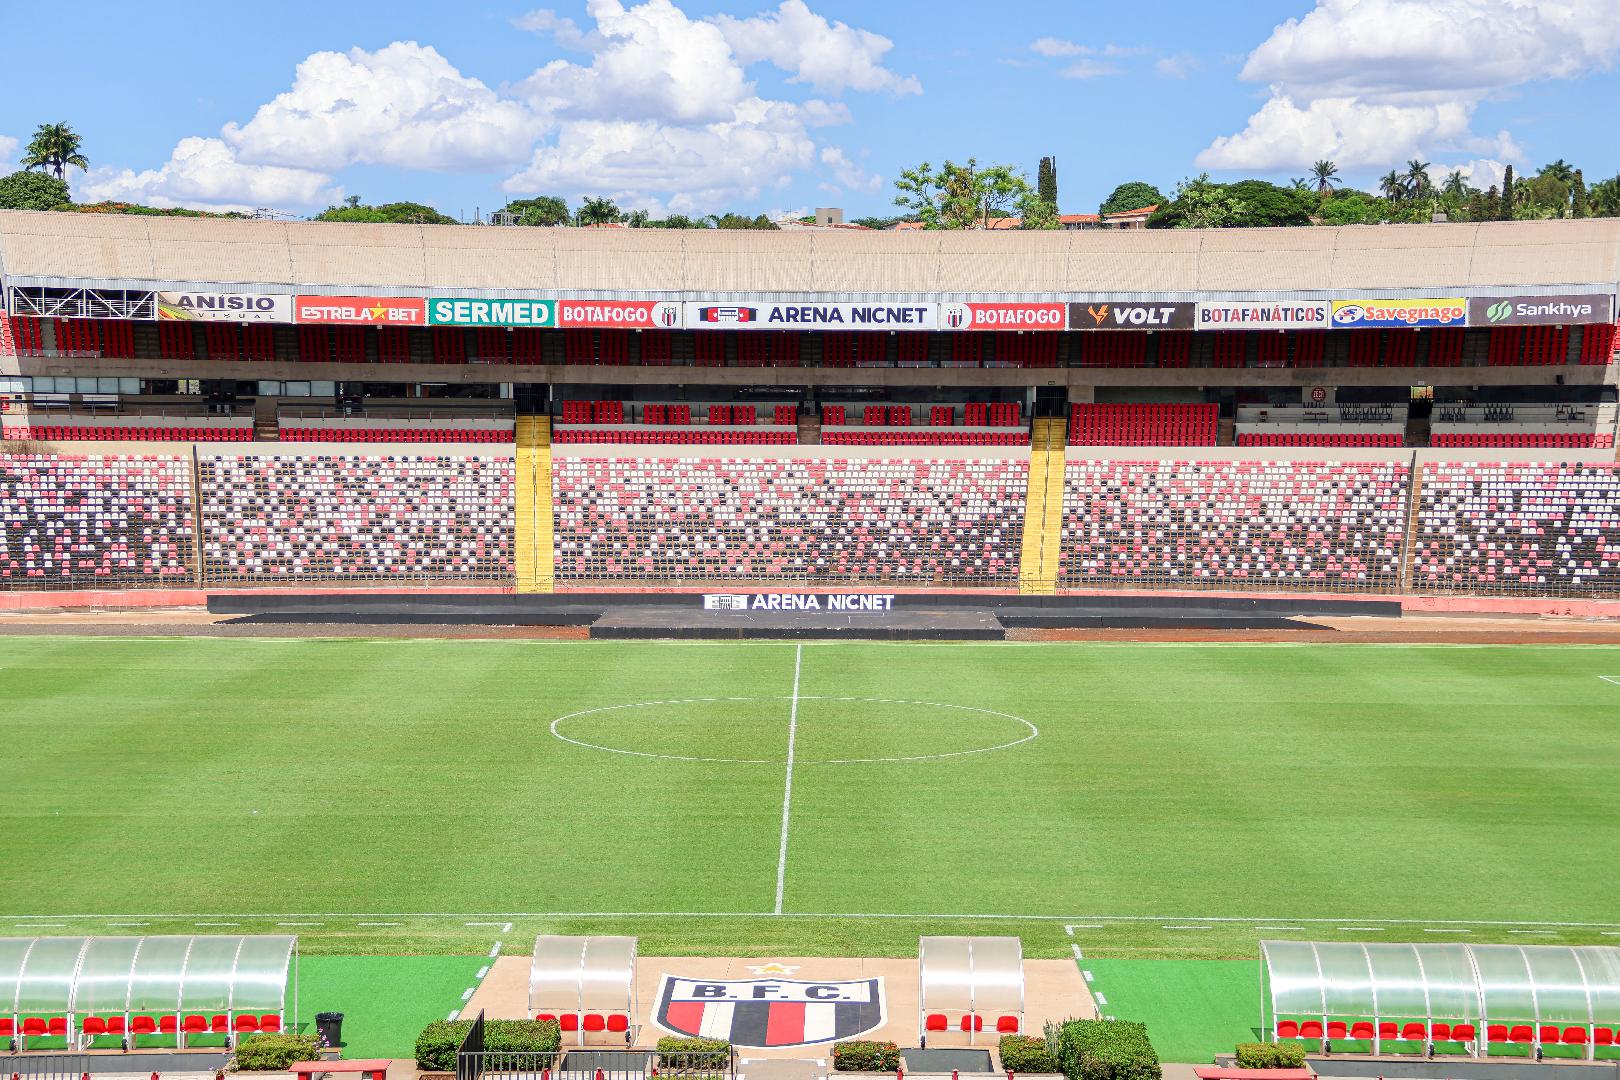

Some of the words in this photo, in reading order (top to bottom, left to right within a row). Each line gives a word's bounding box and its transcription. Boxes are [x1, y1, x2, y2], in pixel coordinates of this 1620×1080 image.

[176, 294, 275, 310] ANÍSIO
[1516, 302, 1592, 317] Sankhya
[198, 312, 275, 320] VISUAL
[301, 306, 373, 321] ESTRELA
[388, 307, 419, 321] BET
[435, 301, 549, 323] SERMED
[563, 306, 648, 322] BOTAFOGO
[768, 306, 844, 323] ARENA
[851, 307, 928, 323] NICNET
[975, 309, 1061, 324] BOTAFOGO
[1113, 307, 1176, 324] VOLT
[1201, 304, 1325, 322] BOTAFANÁTICOS
[1364, 306, 1464, 323] Savegnago
[751, 594, 821, 610] ARENA
[827, 594, 895, 610] NICNET
